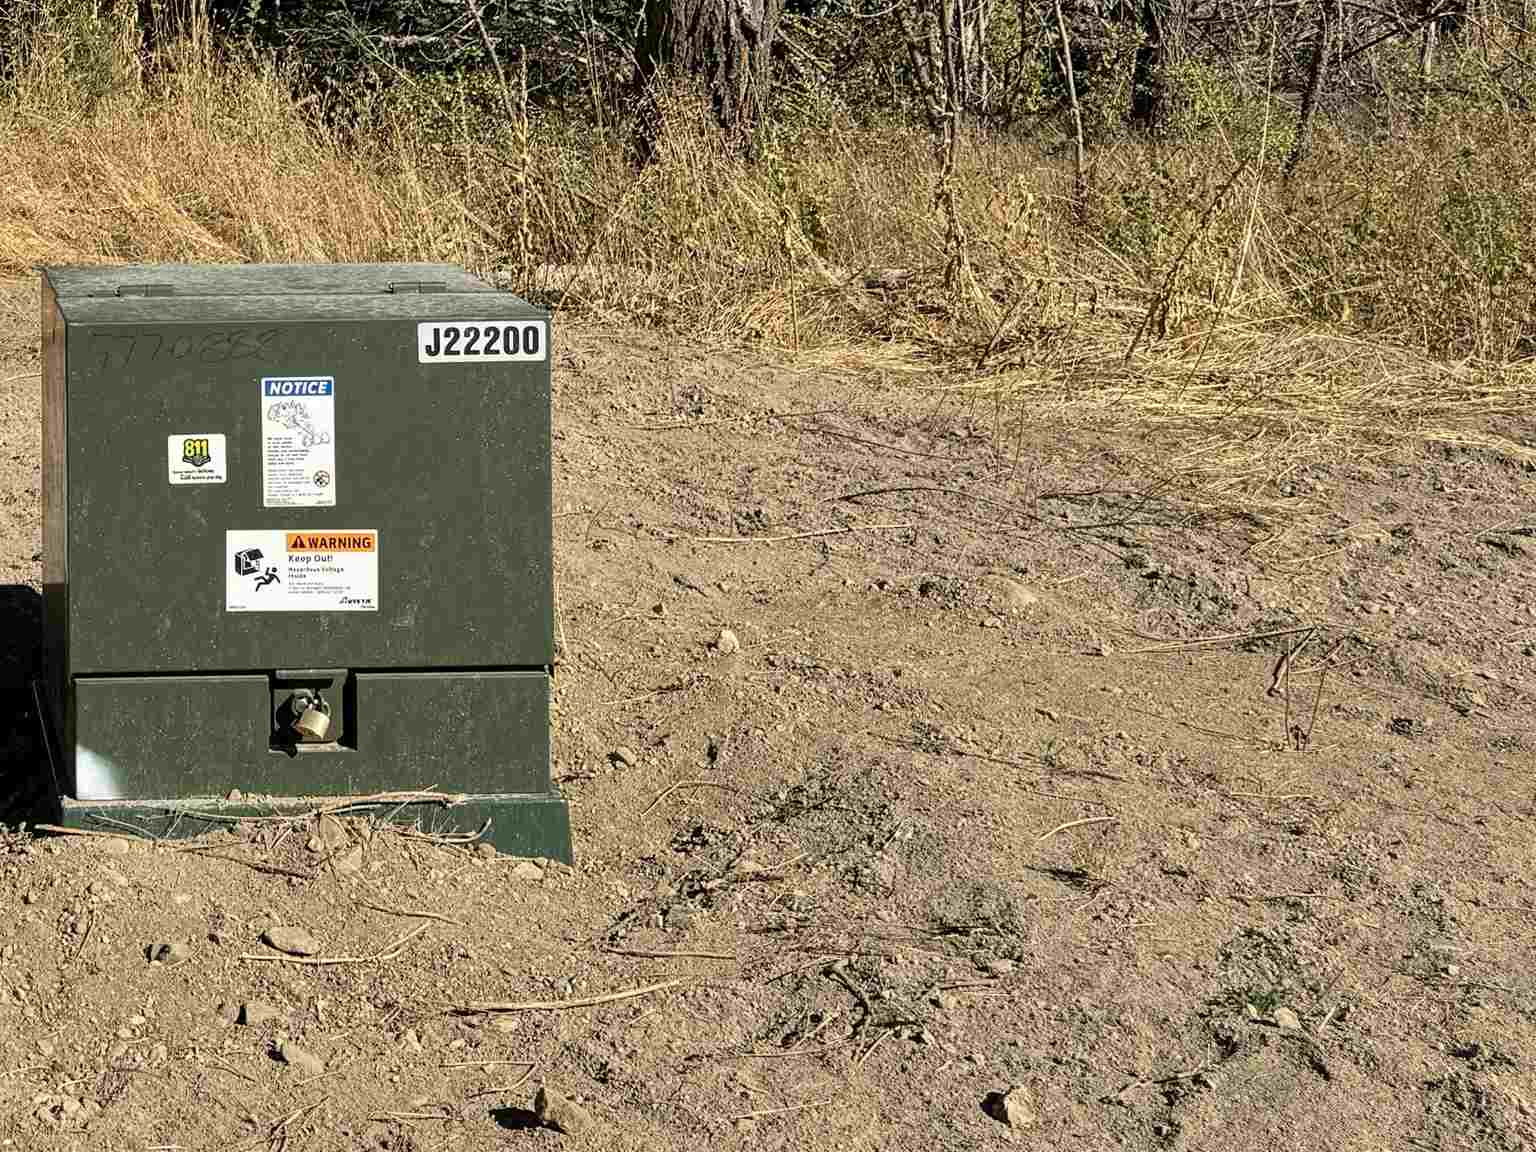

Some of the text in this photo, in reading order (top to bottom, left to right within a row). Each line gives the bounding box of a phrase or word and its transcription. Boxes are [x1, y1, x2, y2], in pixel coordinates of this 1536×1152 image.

[424, 325, 539, 357] J22200
[269, 381, 329, 395] NOTICE
[183, 438, 209, 458] 811
[307, 536, 372, 549] WARNING
[288, 554, 334, 564] Keep Out!
